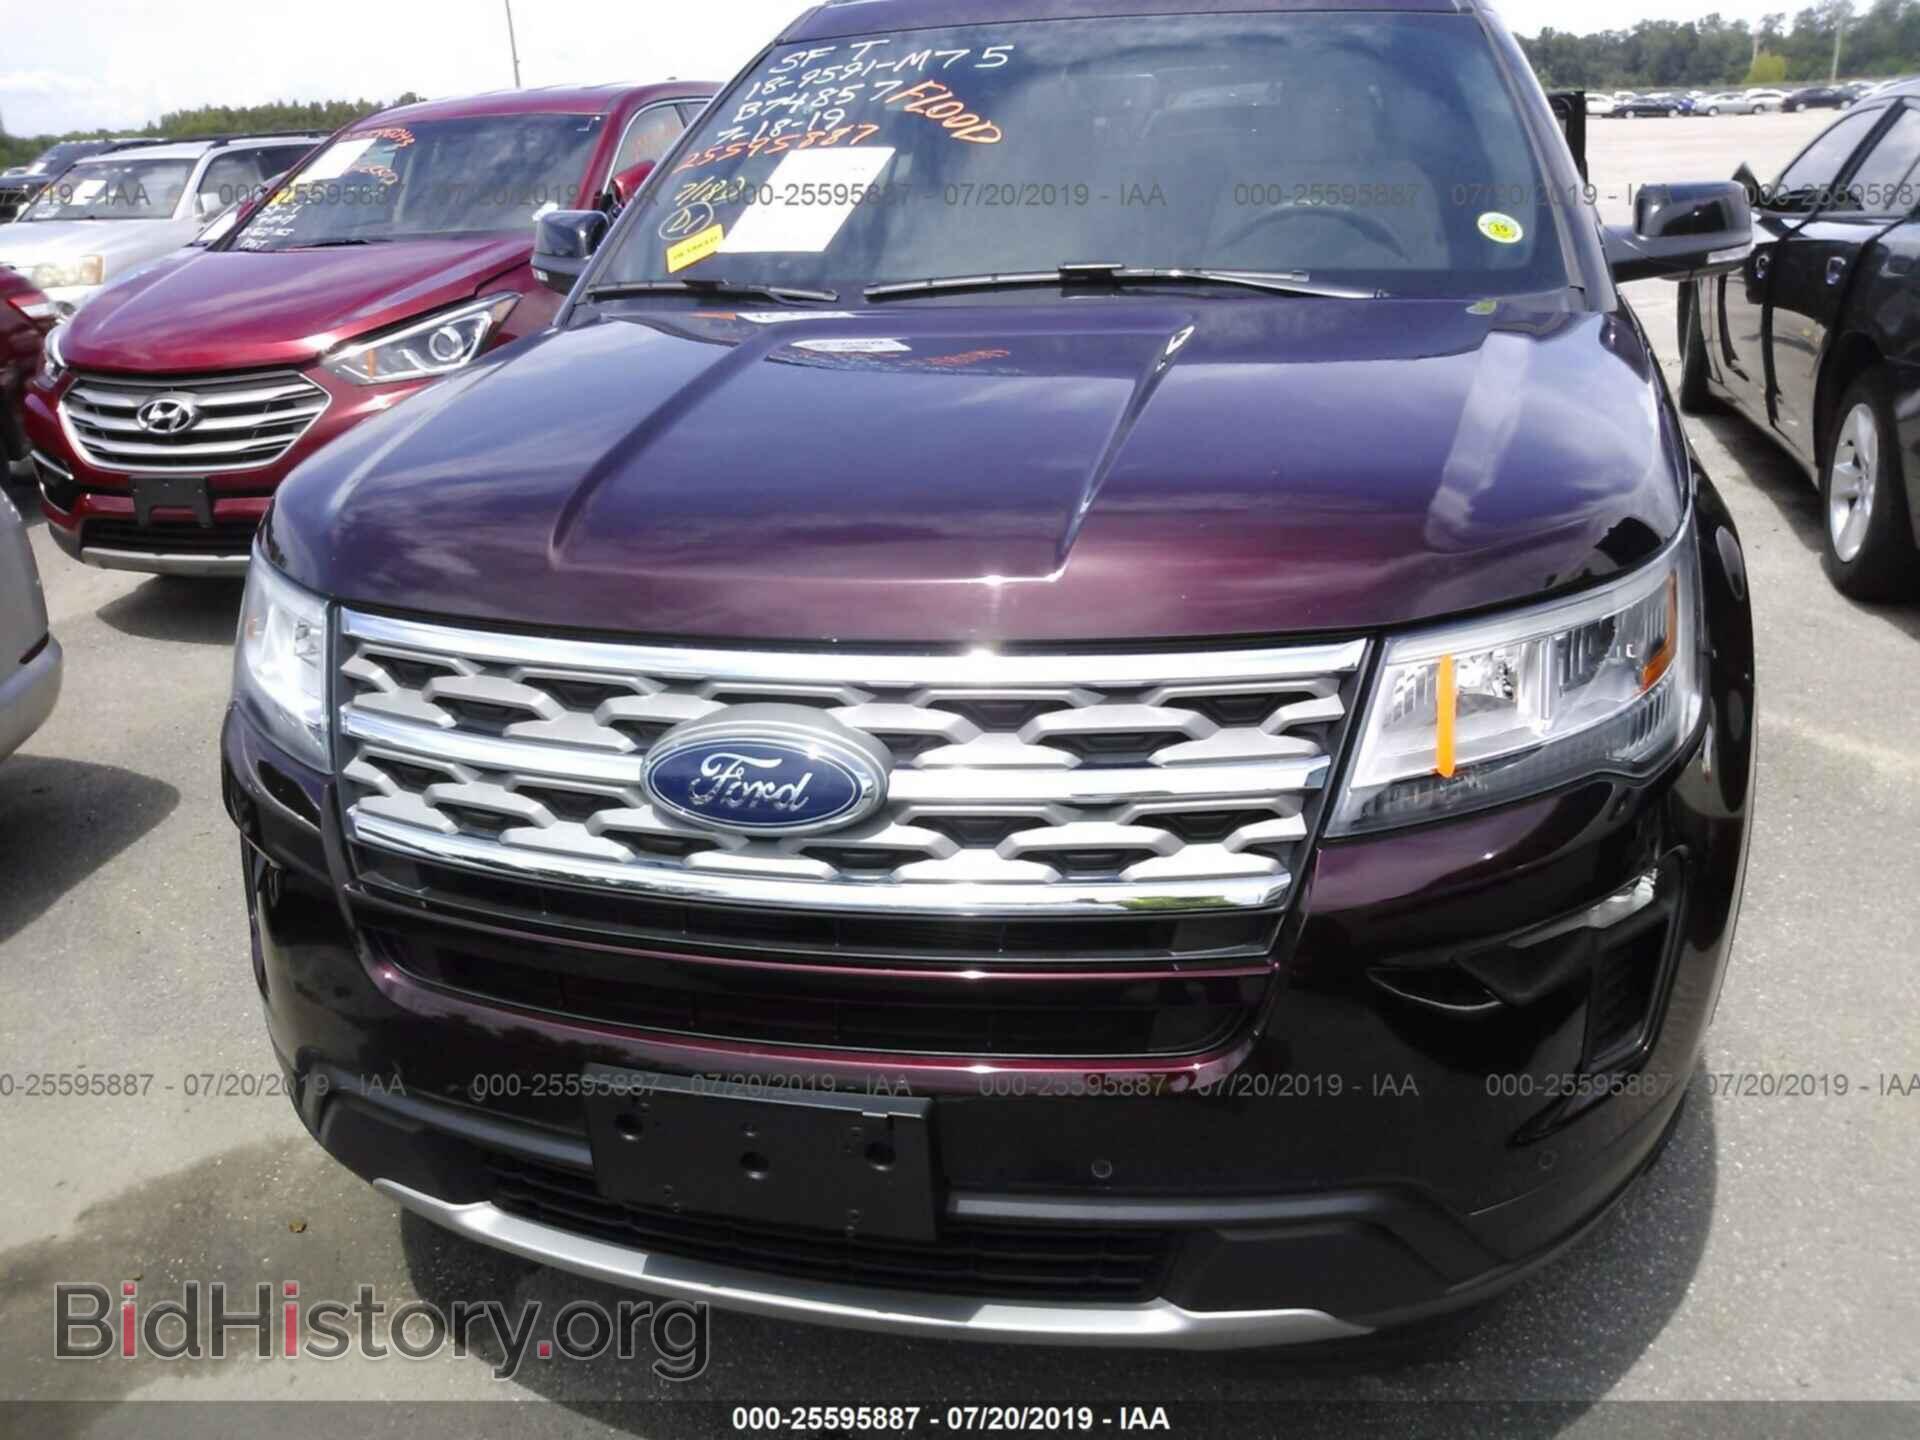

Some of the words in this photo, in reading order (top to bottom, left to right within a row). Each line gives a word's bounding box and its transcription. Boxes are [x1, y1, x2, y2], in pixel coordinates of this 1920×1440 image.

[769, 46, 836, 73] SF
[850, 39, 890, 61] T
[885, 80, 1002, 143] FLOOD
[672, 124, 880, 174] 25595887
[690, 752, 813, 811] Ford
